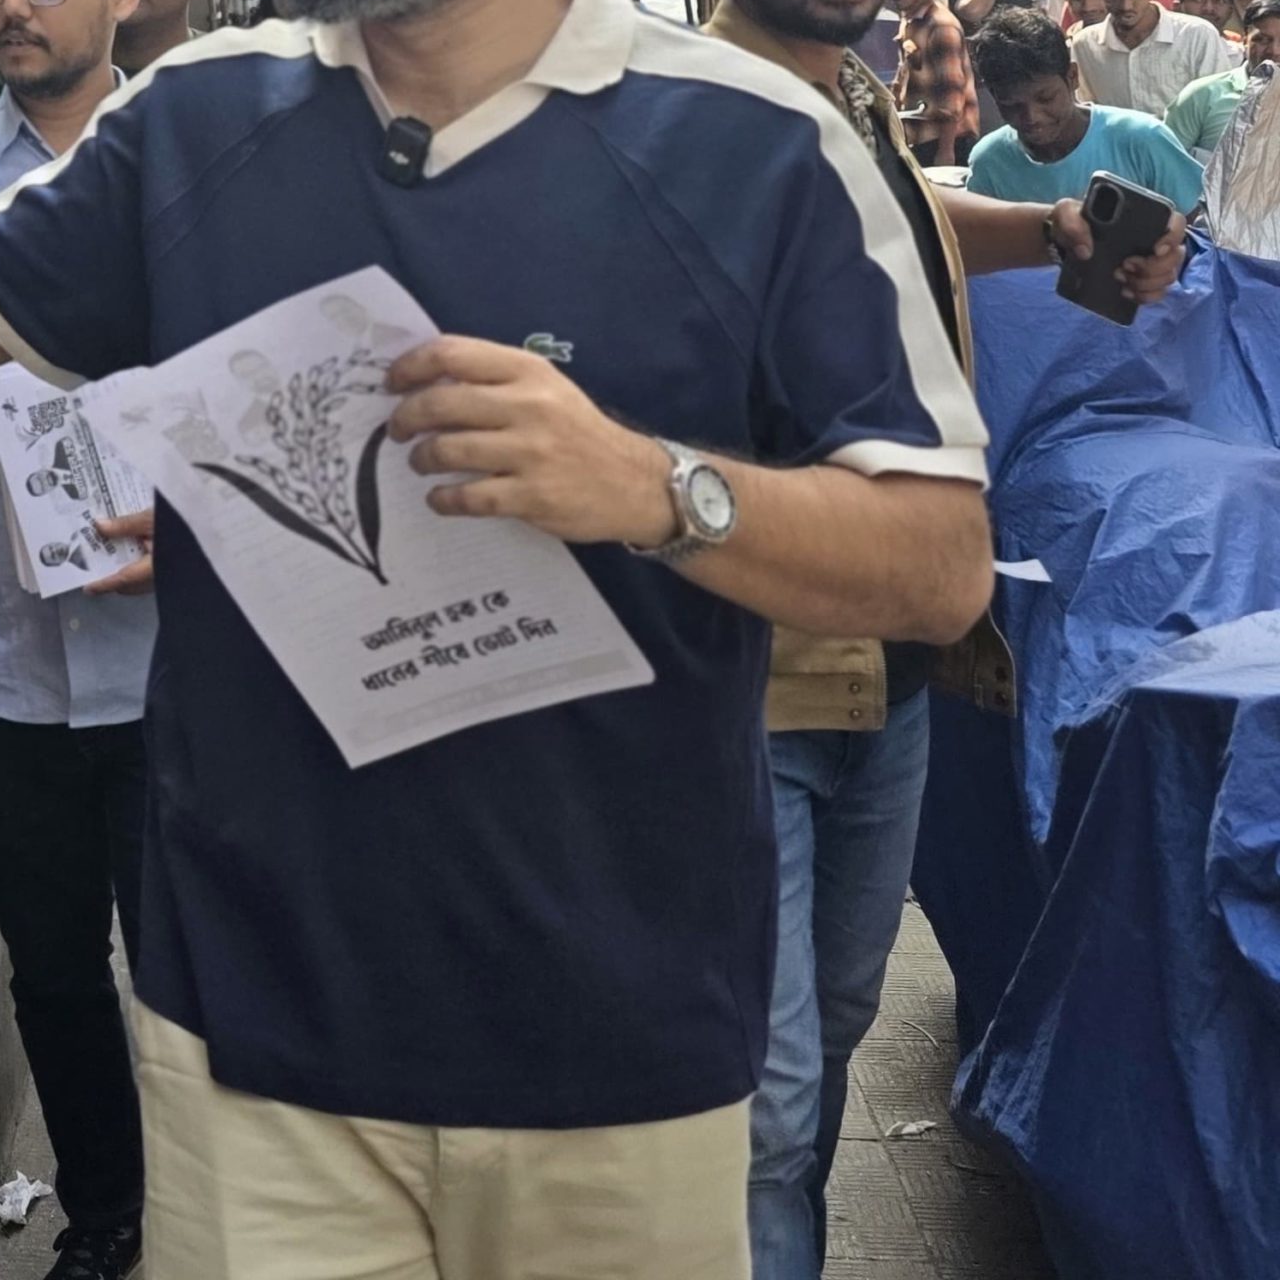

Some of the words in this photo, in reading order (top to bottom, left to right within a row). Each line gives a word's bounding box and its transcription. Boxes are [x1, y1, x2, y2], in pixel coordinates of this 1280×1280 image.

[362, 612, 442, 650] আমিনুল
[482, 591, 509, 612] কে
[363, 660, 419, 690] ধানের
[474, 626, 517, 655] ভোট
[518, 618, 557, 642] দিন
